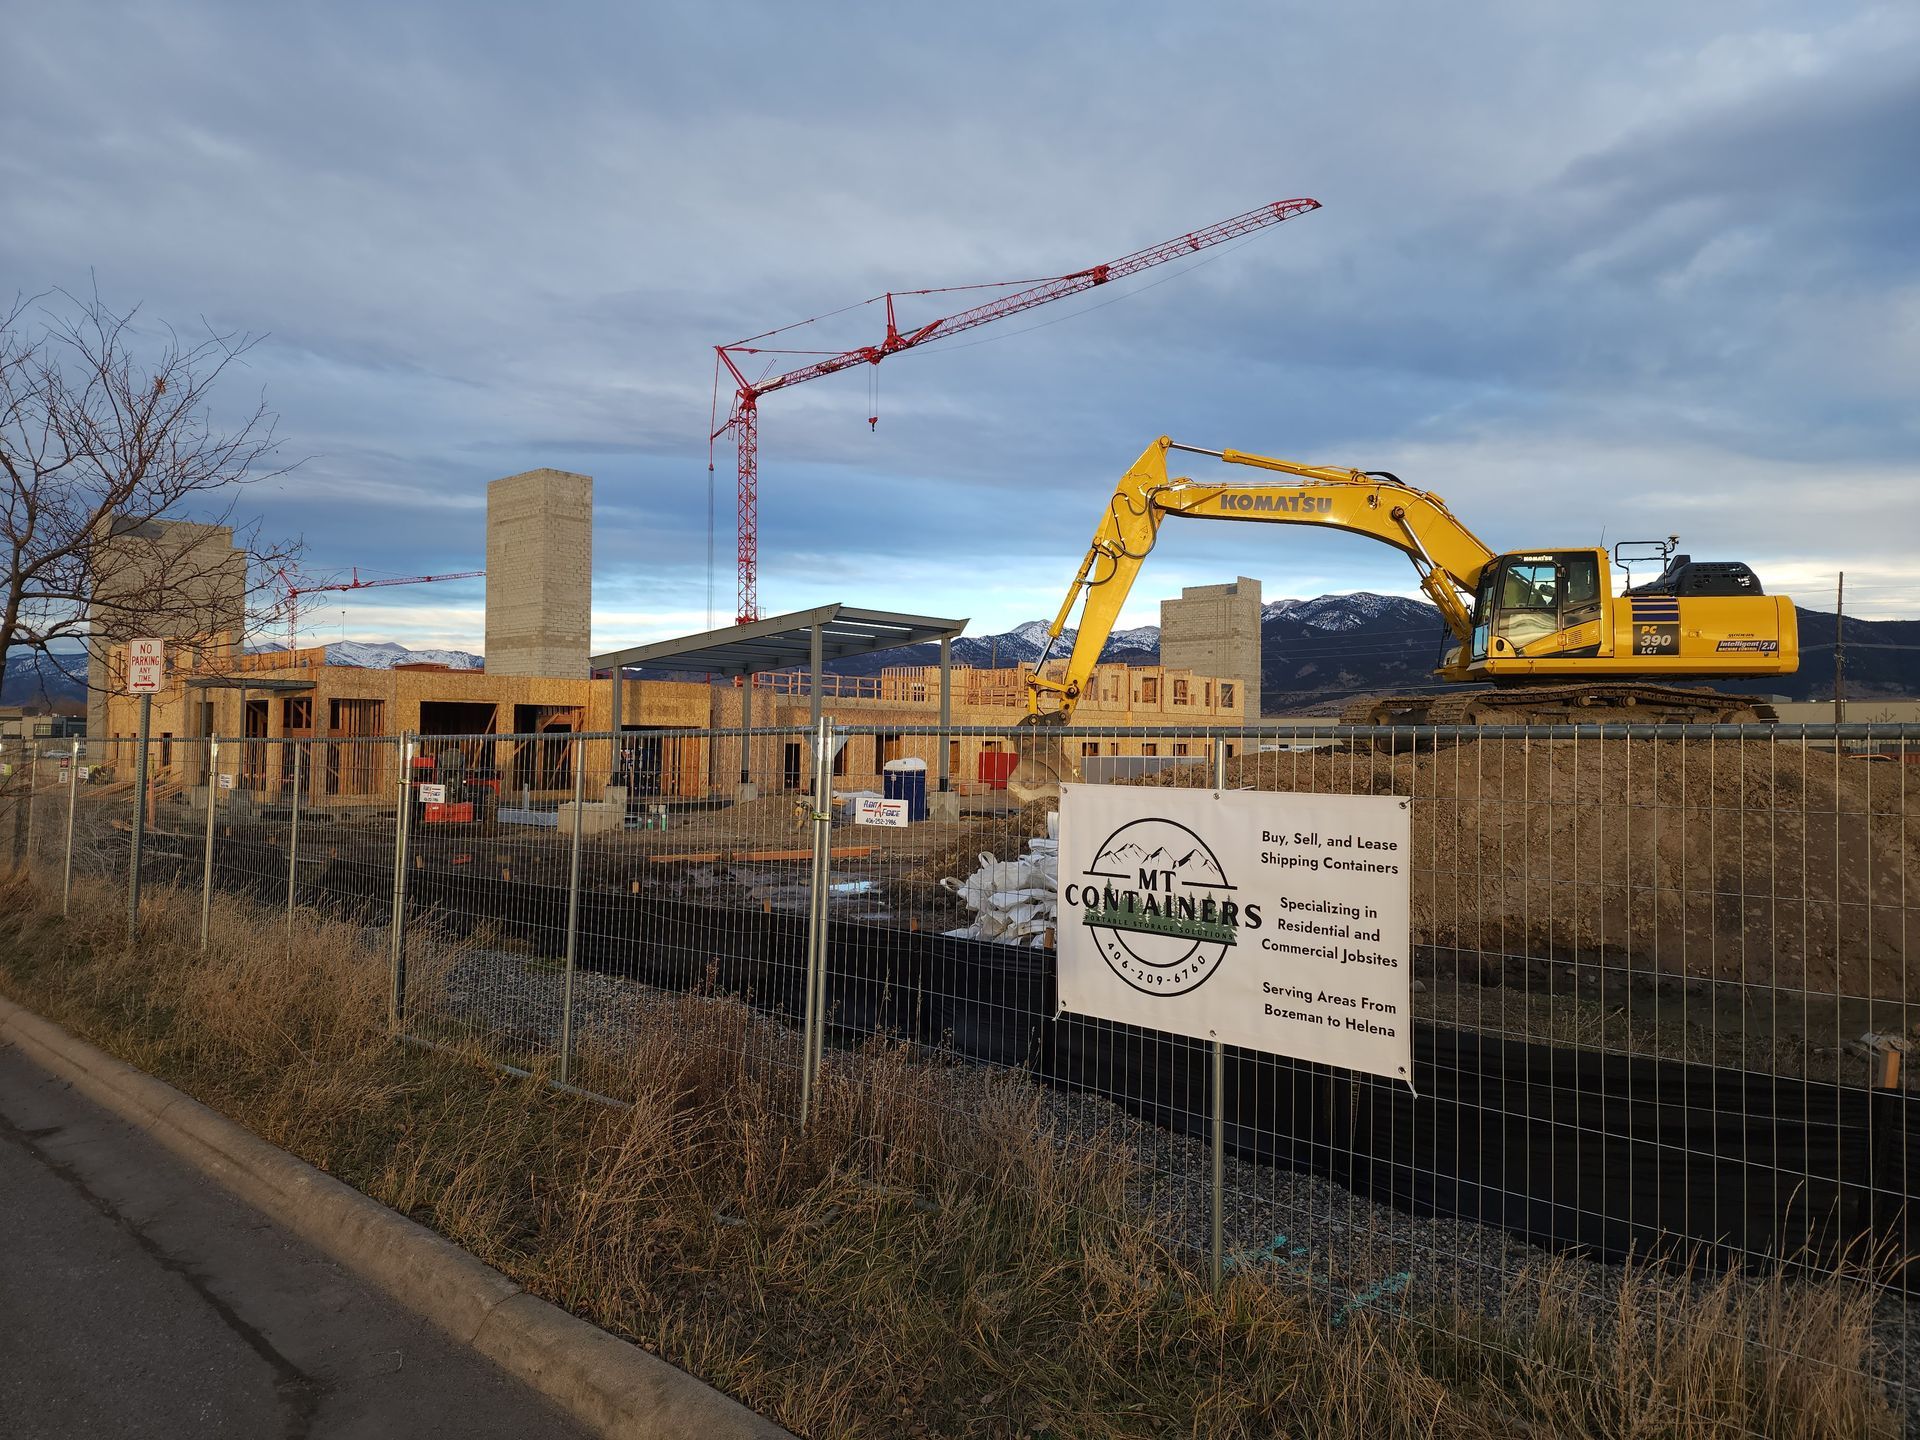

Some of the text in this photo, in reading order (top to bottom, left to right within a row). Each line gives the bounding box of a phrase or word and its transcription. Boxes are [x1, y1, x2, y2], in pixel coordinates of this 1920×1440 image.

[1221, 492, 1332, 513] KOMATSU
[1641, 626, 1657, 634] PC
[1641, 635, 1671, 646] 390
[140, 644, 152, 654] NO
[132, 656, 159, 666] PARKING
[1262, 831, 1397, 851] Buy, Sell, and Lease
[1261, 852, 1398, 874] Shipping Containers
[1139, 868, 1176, 892] MT
[1065, 883, 1262, 929] CONTAINERS
[1280, 897, 1377, 920] Specializing in
[1085, 915, 1234, 940] PORTABLE STORAGE SOLUTIONS
[1278, 919, 1380, 942] Residential and
[1107, 942, 1206, 985] 406-209-6760
[1262, 939, 1398, 968] Commercial Jobsites
[1263, 982, 1396, 1014] Serving Areas From
[1264, 1004, 1395, 1037] Bozeman to Helena
